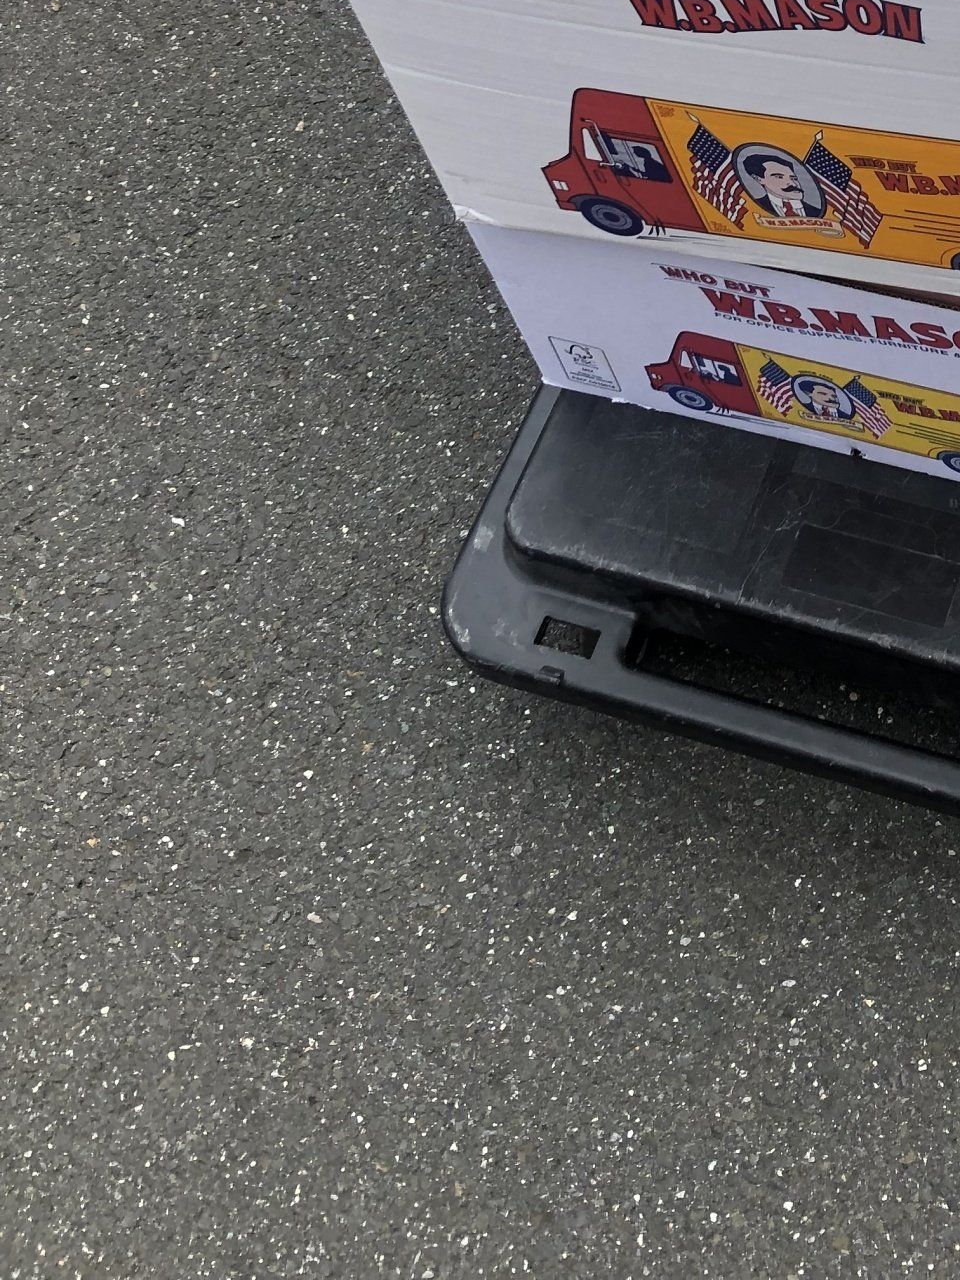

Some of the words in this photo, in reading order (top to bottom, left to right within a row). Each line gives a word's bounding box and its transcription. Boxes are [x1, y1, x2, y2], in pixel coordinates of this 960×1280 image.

[849, 156, 886, 169] WHO
[887, 160, 918, 174] BUT
[658, 265, 718, 287] WHO
[723, 278, 772, 299] BUT
[714, 312, 743, 323] FOR
[746, 317, 796, 334] OFFICE
[798, 327, 868, 345] SUPPLIES,
[869, 337, 951, 357] FURNITURE
